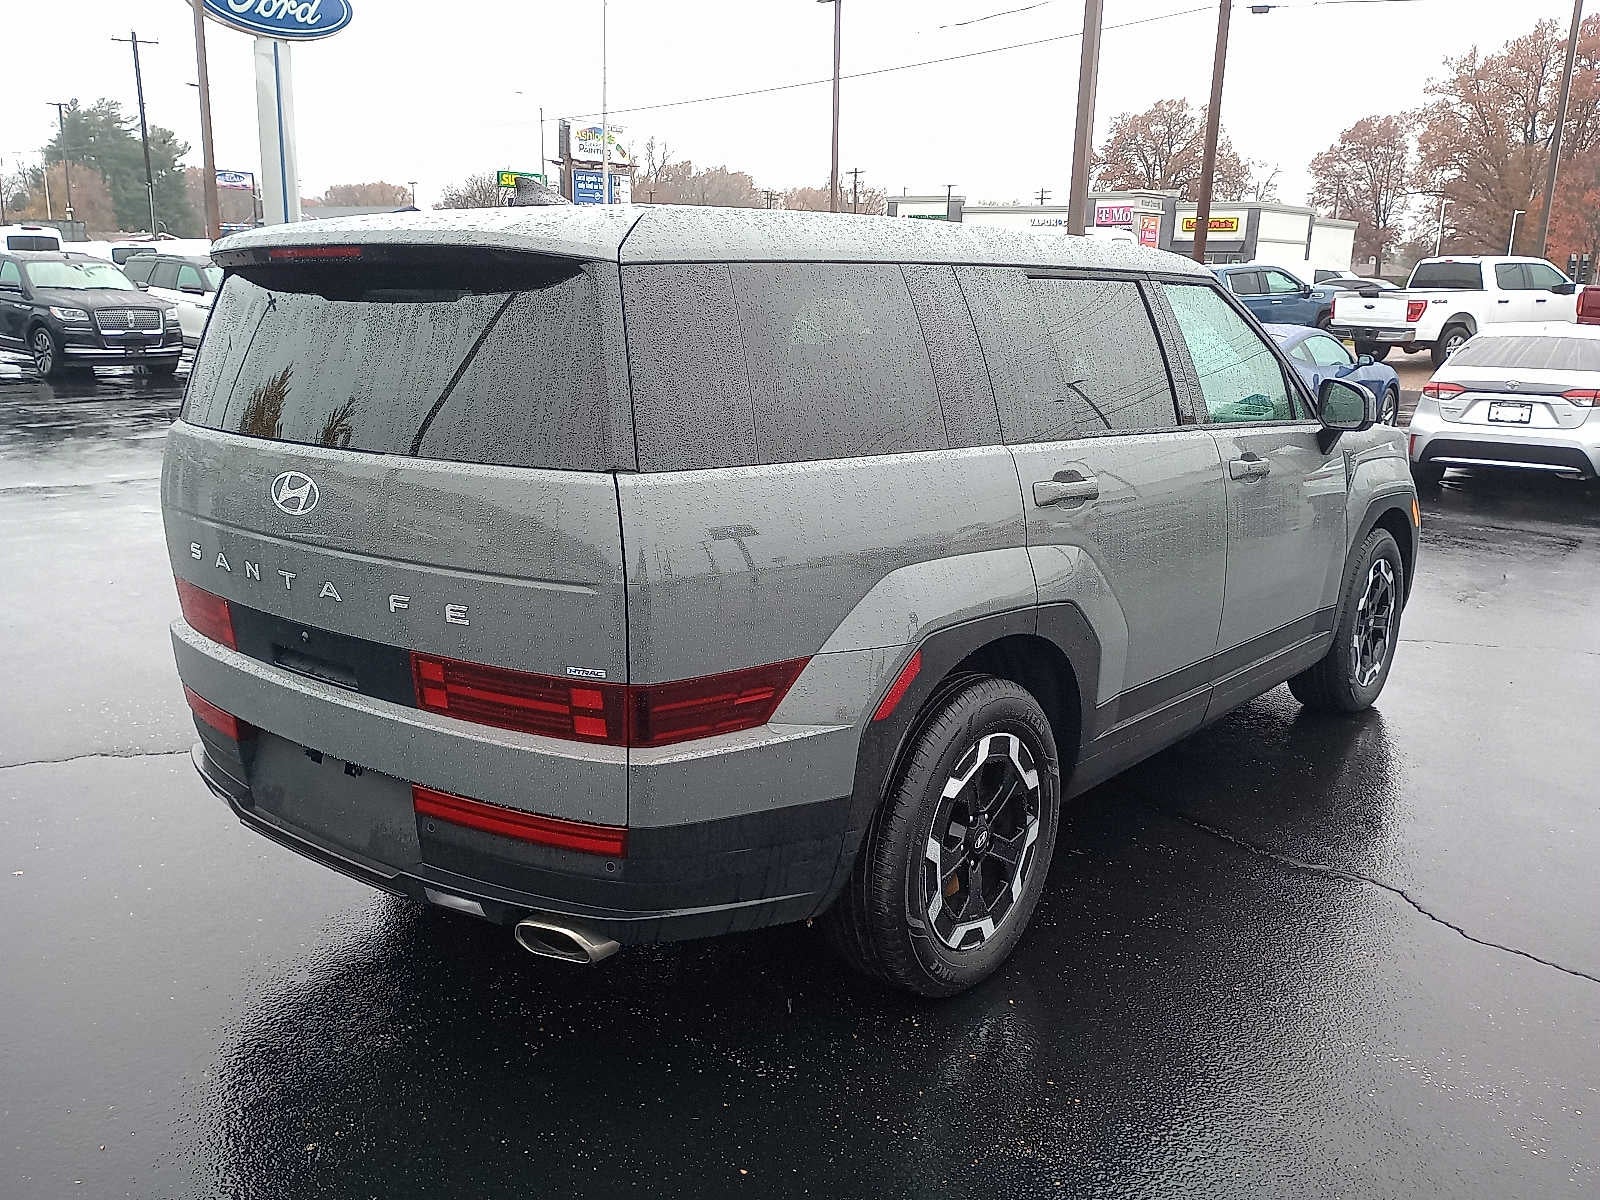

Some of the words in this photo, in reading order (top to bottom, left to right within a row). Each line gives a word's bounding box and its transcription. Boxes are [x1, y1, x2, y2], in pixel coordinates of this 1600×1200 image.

[190, 542, 343, 602] SANTA
[388, 594, 471, 626] FE
[567, 667, 606, 678] HTRAC
